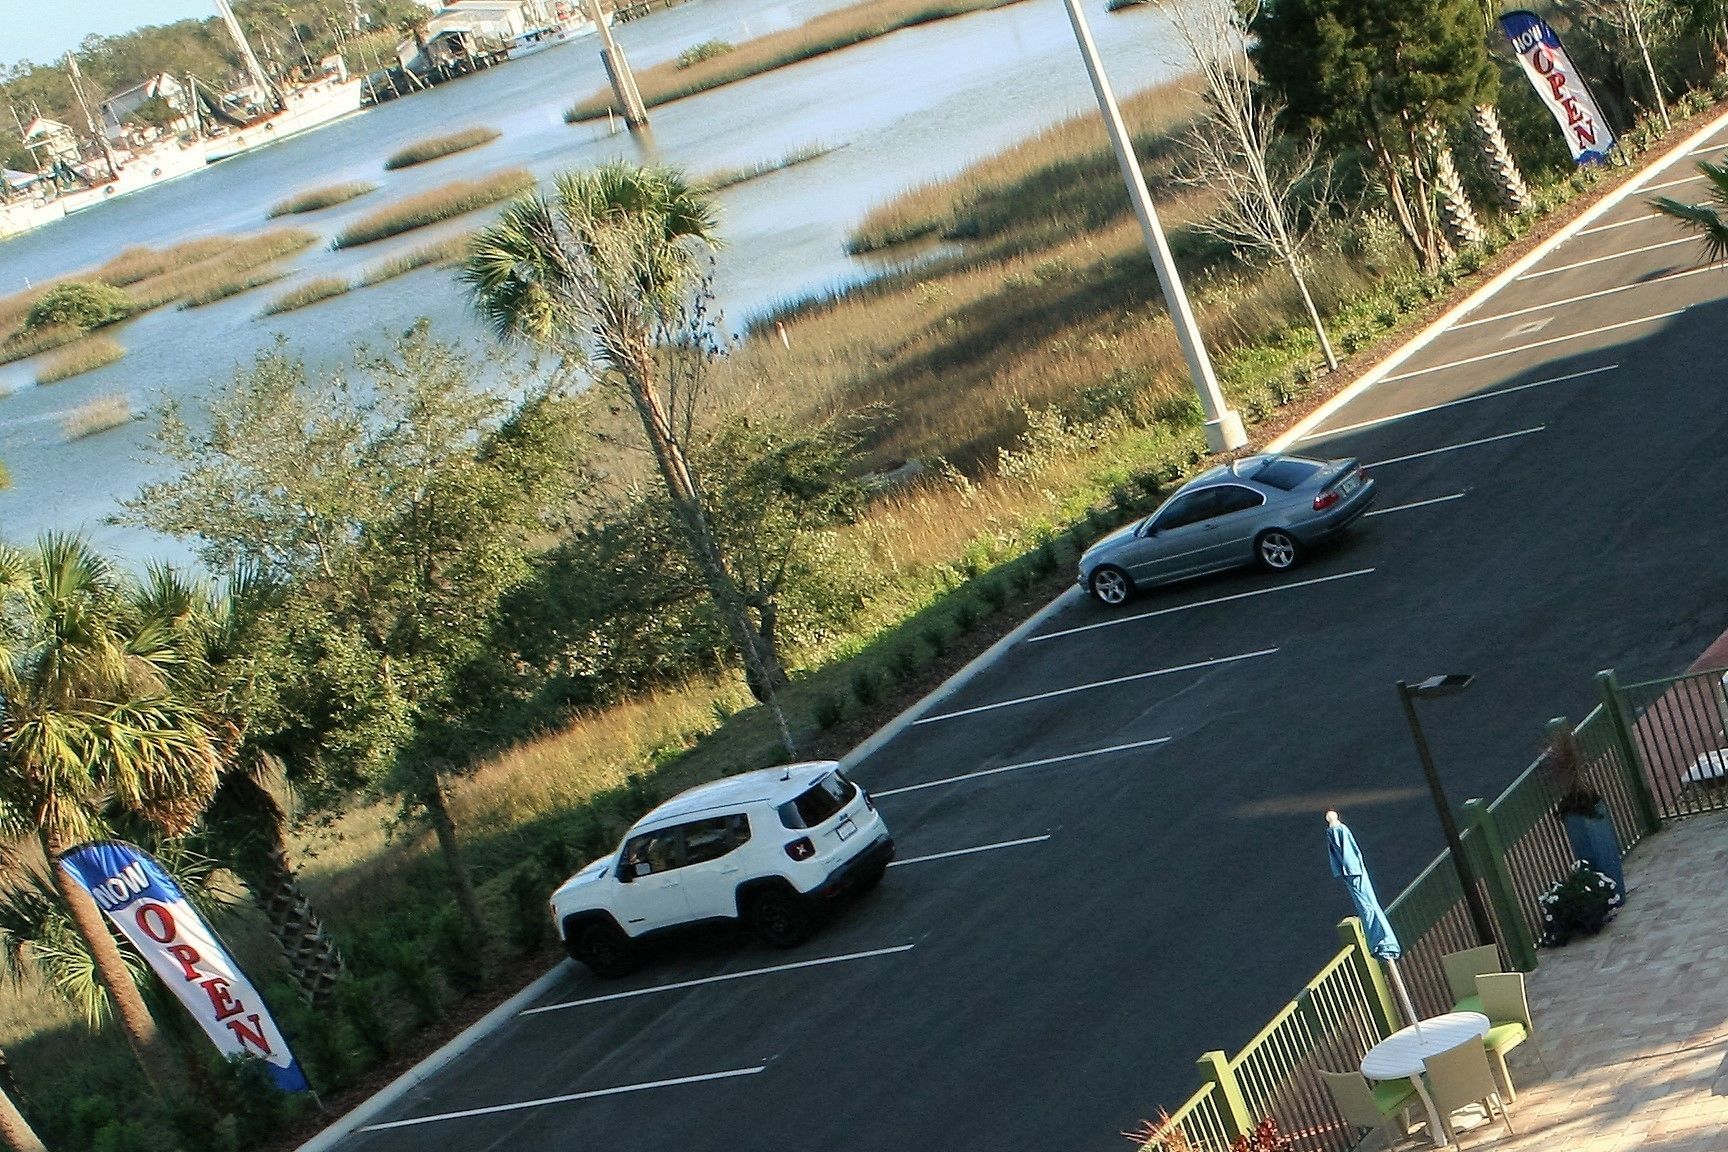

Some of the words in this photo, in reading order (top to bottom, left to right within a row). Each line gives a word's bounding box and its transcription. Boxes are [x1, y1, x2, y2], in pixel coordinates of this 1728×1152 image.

[1512, 24, 1543, 54] NOW
[1532, 47, 1597, 150] OPEN
[93, 861, 150, 910] NOW
[135, 902, 272, 1055] OPEN
